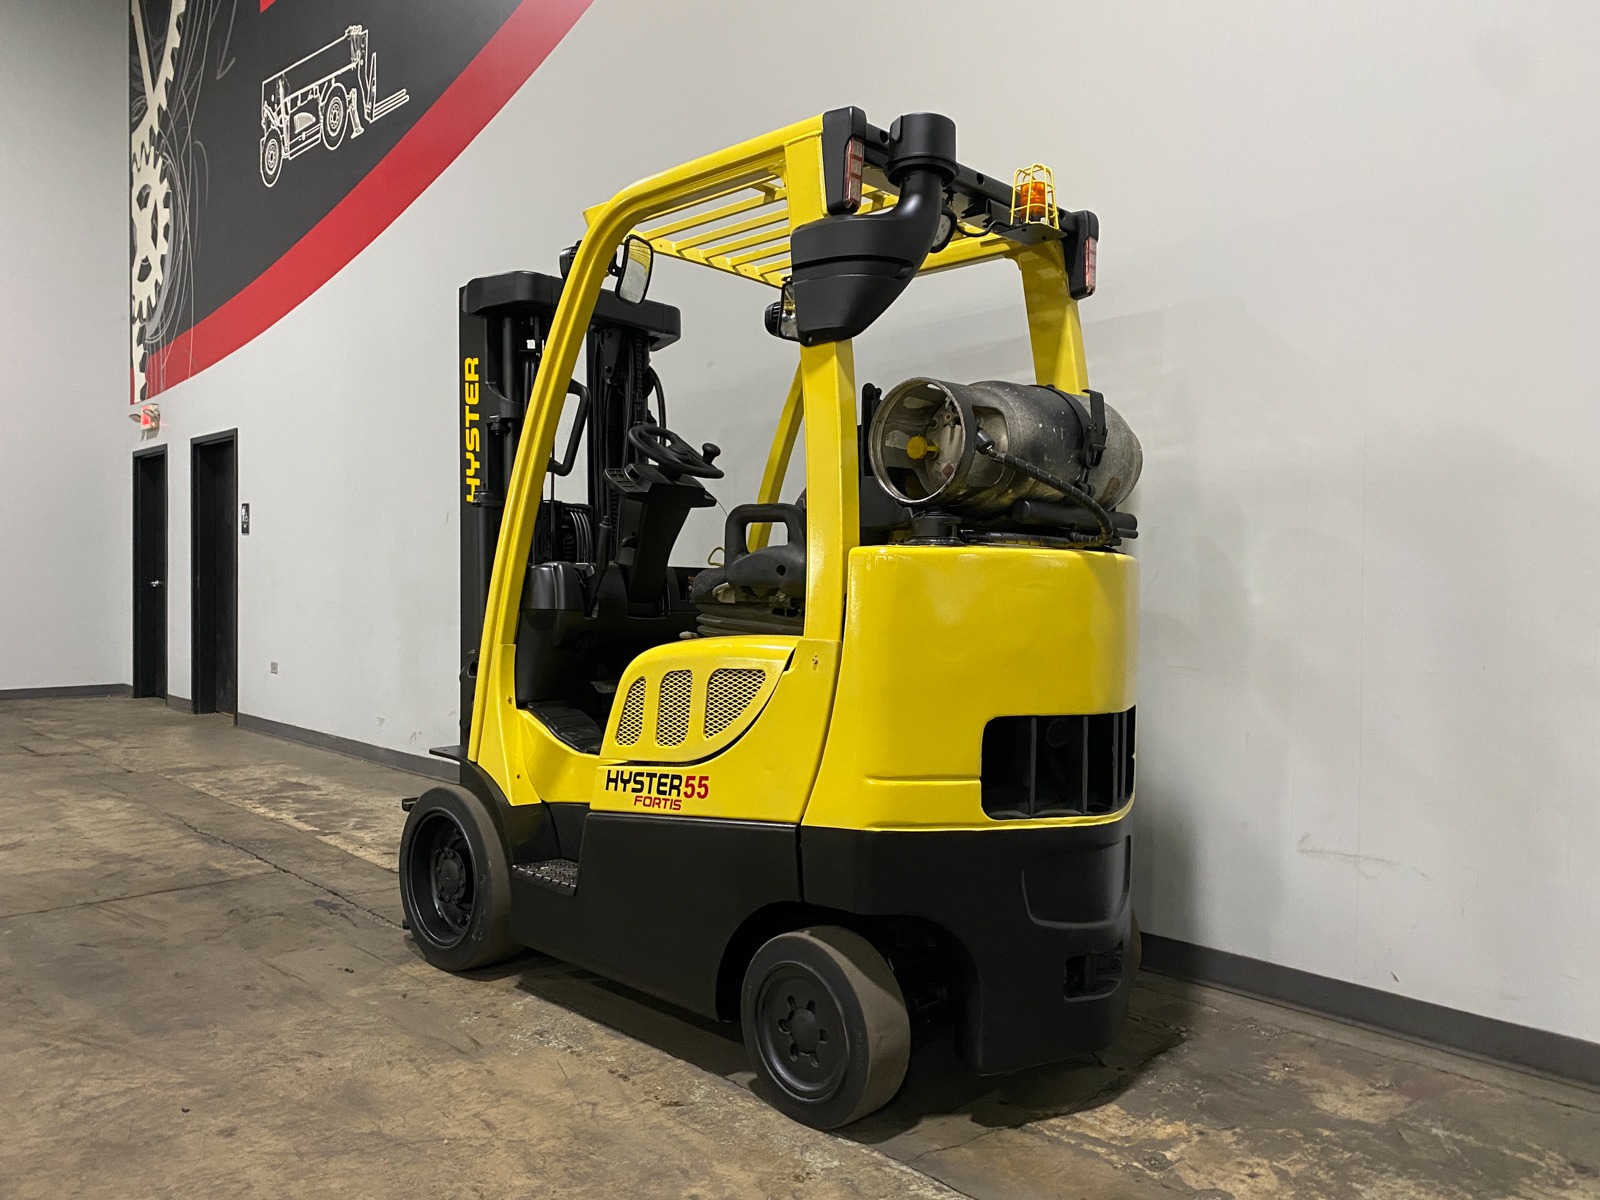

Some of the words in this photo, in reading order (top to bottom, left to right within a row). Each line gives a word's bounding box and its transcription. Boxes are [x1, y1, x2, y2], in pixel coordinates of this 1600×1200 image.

[464, 357, 481, 503] HYSTER
[605, 769, 683, 797] HYSTER
[683, 775, 710, 799] 55
[633, 795, 682, 811] FORTIS
